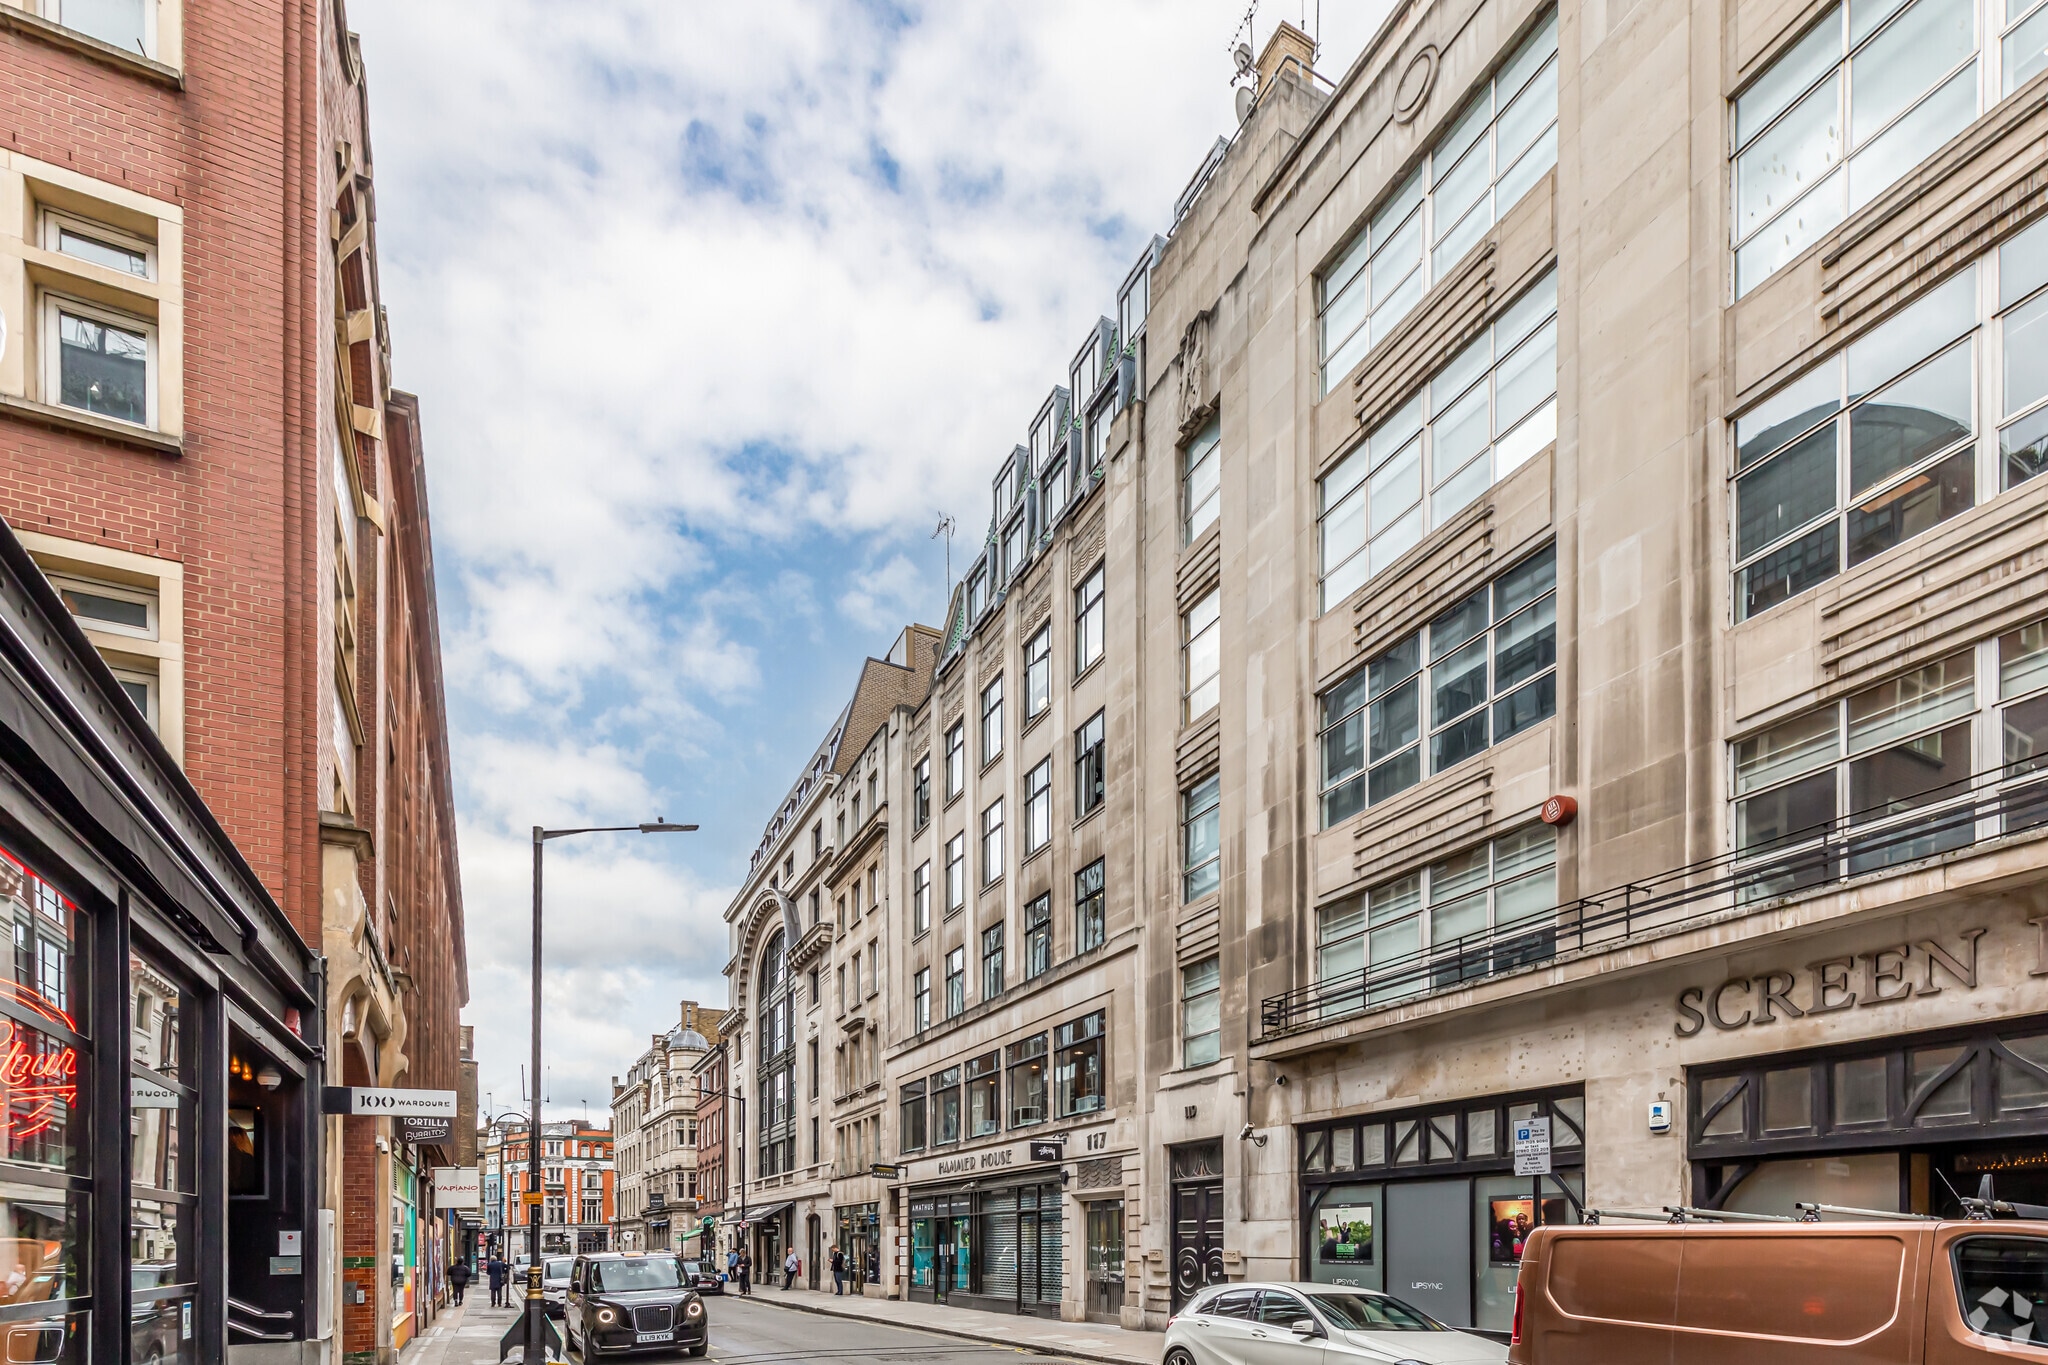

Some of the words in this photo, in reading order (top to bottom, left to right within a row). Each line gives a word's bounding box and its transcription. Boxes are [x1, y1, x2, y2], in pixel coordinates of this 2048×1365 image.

[1674, 928, 1988, 1038] SCREEN
[397, 1099, 443, 1108] WARDOUR
[403, 1117, 449, 1127] TORTILLA
[405, 1129, 447, 1141] BURRITOS
[1086, 1132, 1107, 1151] 117
[938, 1157, 976, 1175] HAMMER
[980, 1150, 1013, 1169] HOUSE
[911, 1203, 934, 1212] AMATHUS
[1332, 1278, 1359, 1286] LIPSYNC
[1411, 1281, 1444, 1290] LIPSYNC
